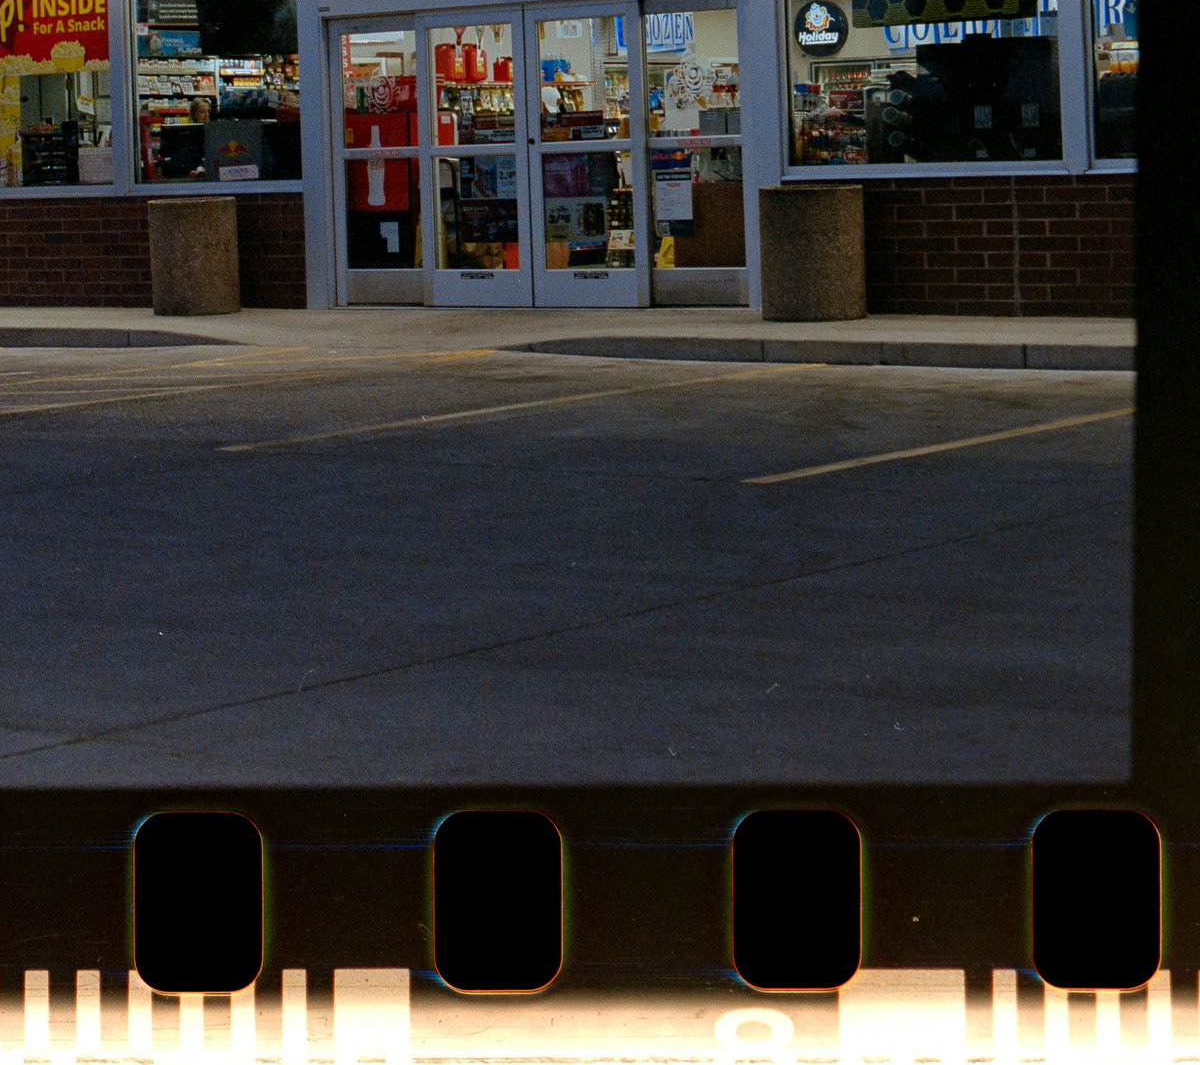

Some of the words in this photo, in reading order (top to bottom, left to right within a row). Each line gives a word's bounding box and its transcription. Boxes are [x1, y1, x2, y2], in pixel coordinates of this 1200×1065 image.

[33, 21, 53, 35] For
[56, 20, 65, 33] A
[68, 17, 106, 32] Snack
[798, 30, 839, 45] Holiday
